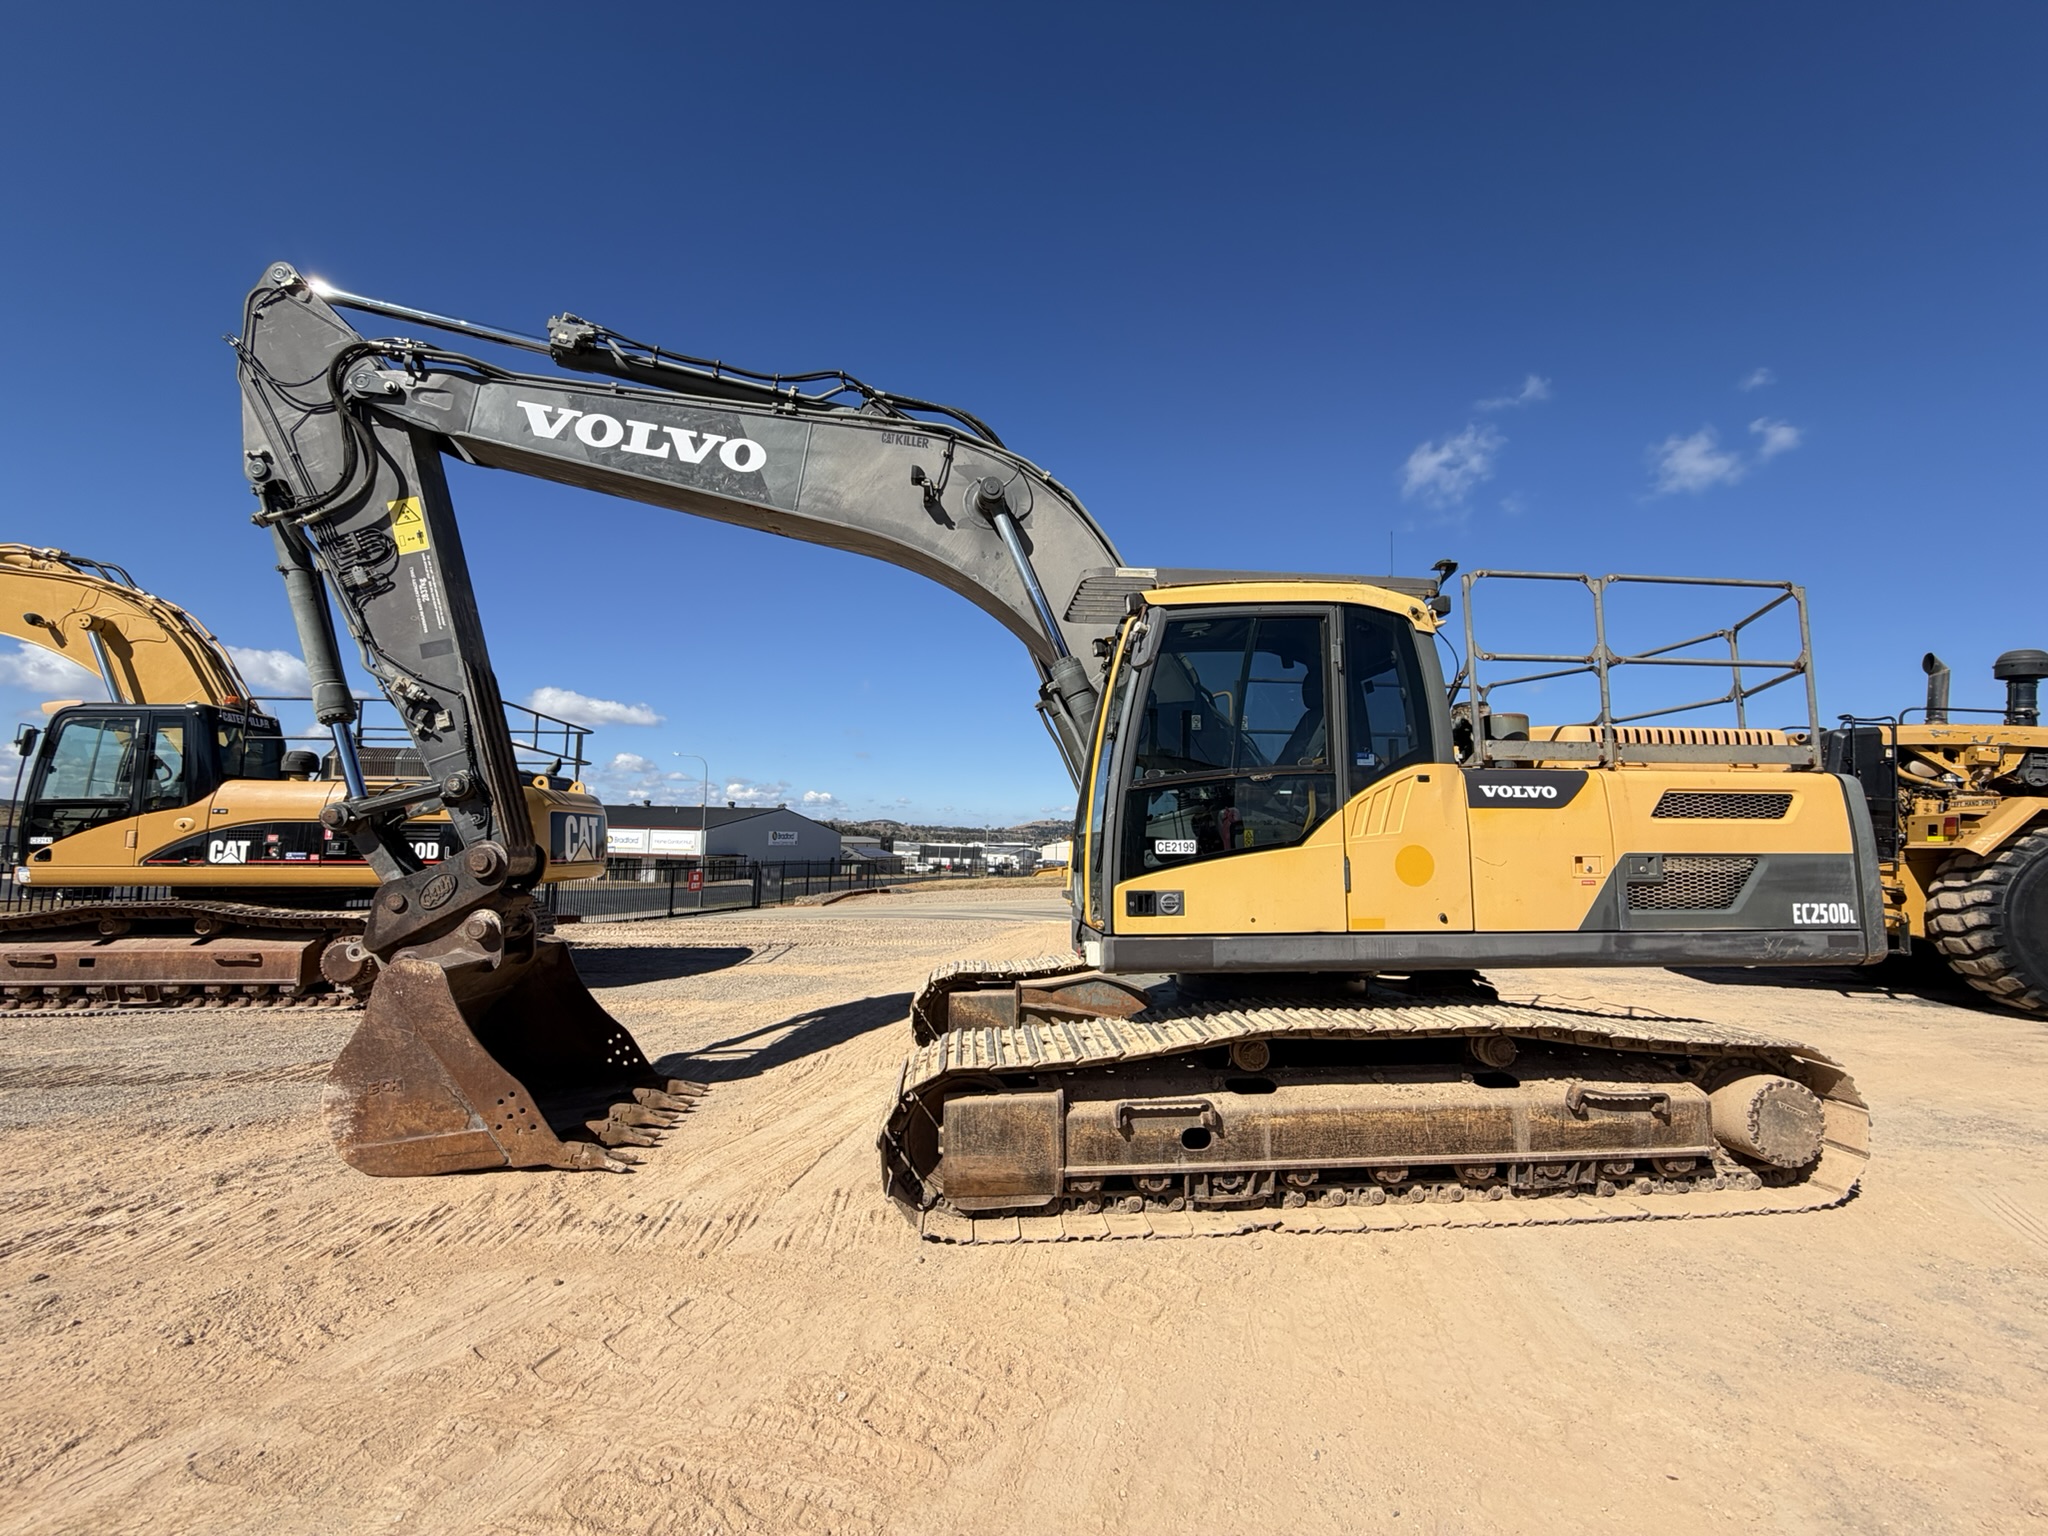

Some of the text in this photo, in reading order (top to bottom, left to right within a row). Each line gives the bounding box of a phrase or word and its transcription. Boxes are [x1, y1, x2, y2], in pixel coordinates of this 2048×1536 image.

[517, 401, 767, 472] VOLVO
[882, 433, 929, 449] CAT KILLER
[1479, 785, 1557, 799] VOLVO
[565, 815, 599, 863] CAT
[614, 836, 639, 844] Bradford
[209, 840, 251, 864] CAT
[1157, 842, 1195, 853] CE2199
